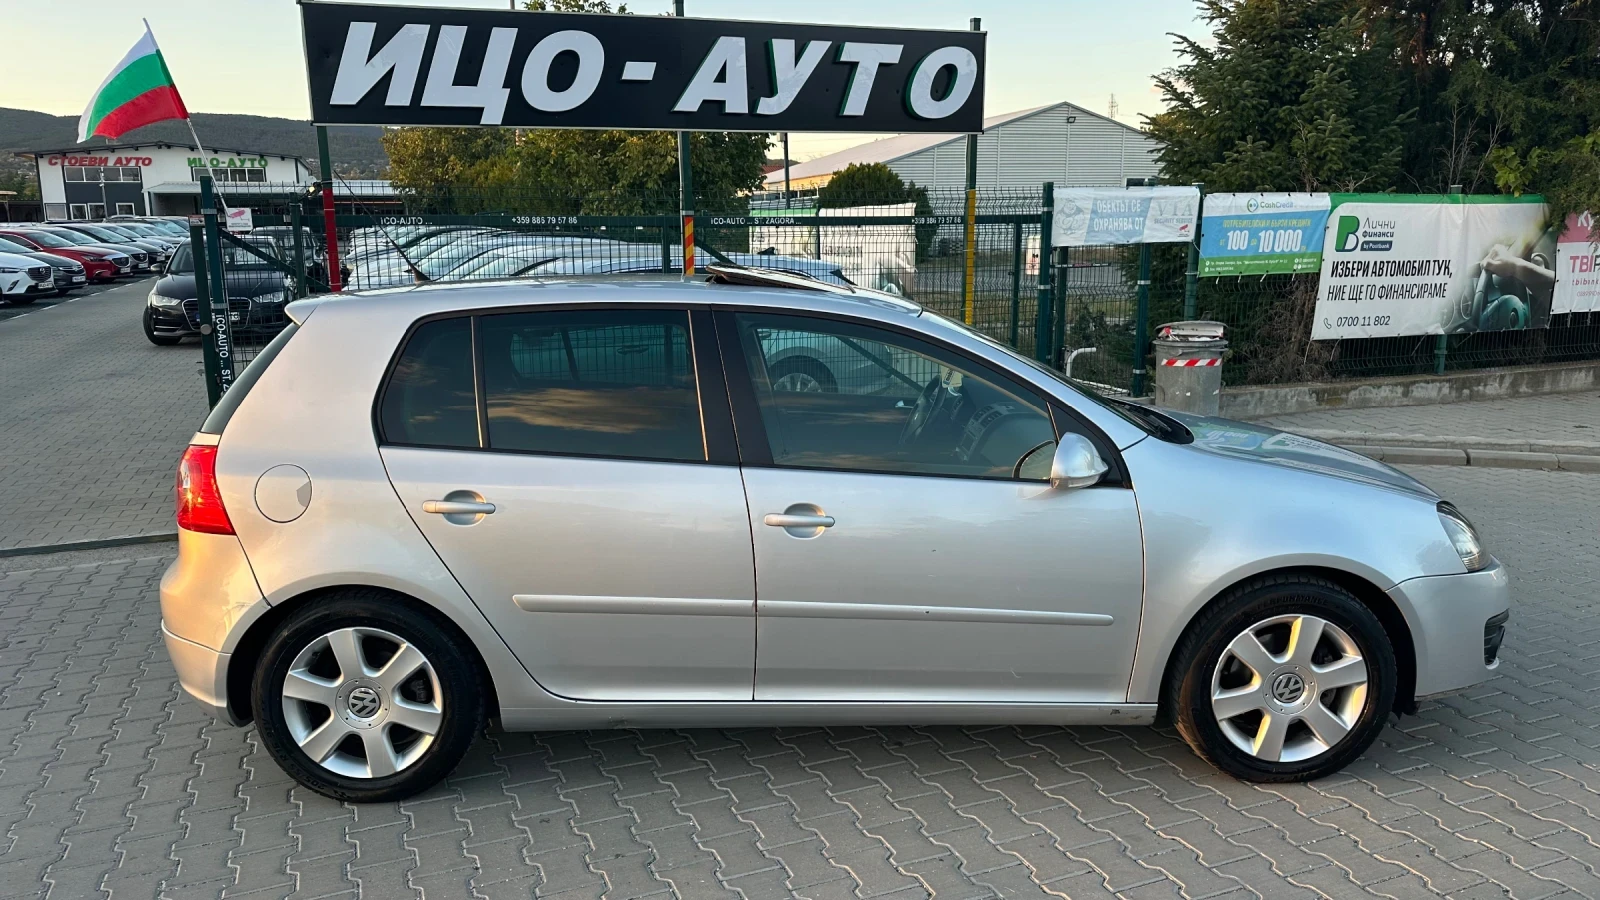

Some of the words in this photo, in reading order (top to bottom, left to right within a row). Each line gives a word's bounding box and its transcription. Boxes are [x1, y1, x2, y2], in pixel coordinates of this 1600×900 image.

[48, 155, 109, 167] СТОЕВИ
[113, 156, 153, 167] АУТО
[1096, 199, 1130, 214] ОБЕКТЪТ
[1130, 199, 1141, 213] СЕ
[1260, 201, 1294, 209] CashCredit
[547, 216, 557, 224] 79
[568, 216, 578, 224] 86
[764, 217, 795, 225] ZAGORA
[1093, 217, 1133, 232] ОХРАНЯВА
[1134, 217, 1145, 231] ОТ
[1362, 216, 1396, 230] Лични
[1227, 229, 1249, 251] 100
[1330, 259, 1370, 278] ИЗБЕРИ
[1371, 258, 1433, 278] АВТОМОБИЛ
[1432, 258, 1453, 279] ТУК,
[1327, 284, 1347, 302] НИЕ
[1349, 283, 1364, 303] ЩЕ
[1364, 283, 1376, 300] ГО
[1377, 281, 1448, 300] ФИНАНСИРАМЕ
[1336, 315, 1359, 328] 0700
[1360, 315, 1371, 327] 11
[1373, 314, 1391, 327] 802
[221, 369, 232, 383] ST.
